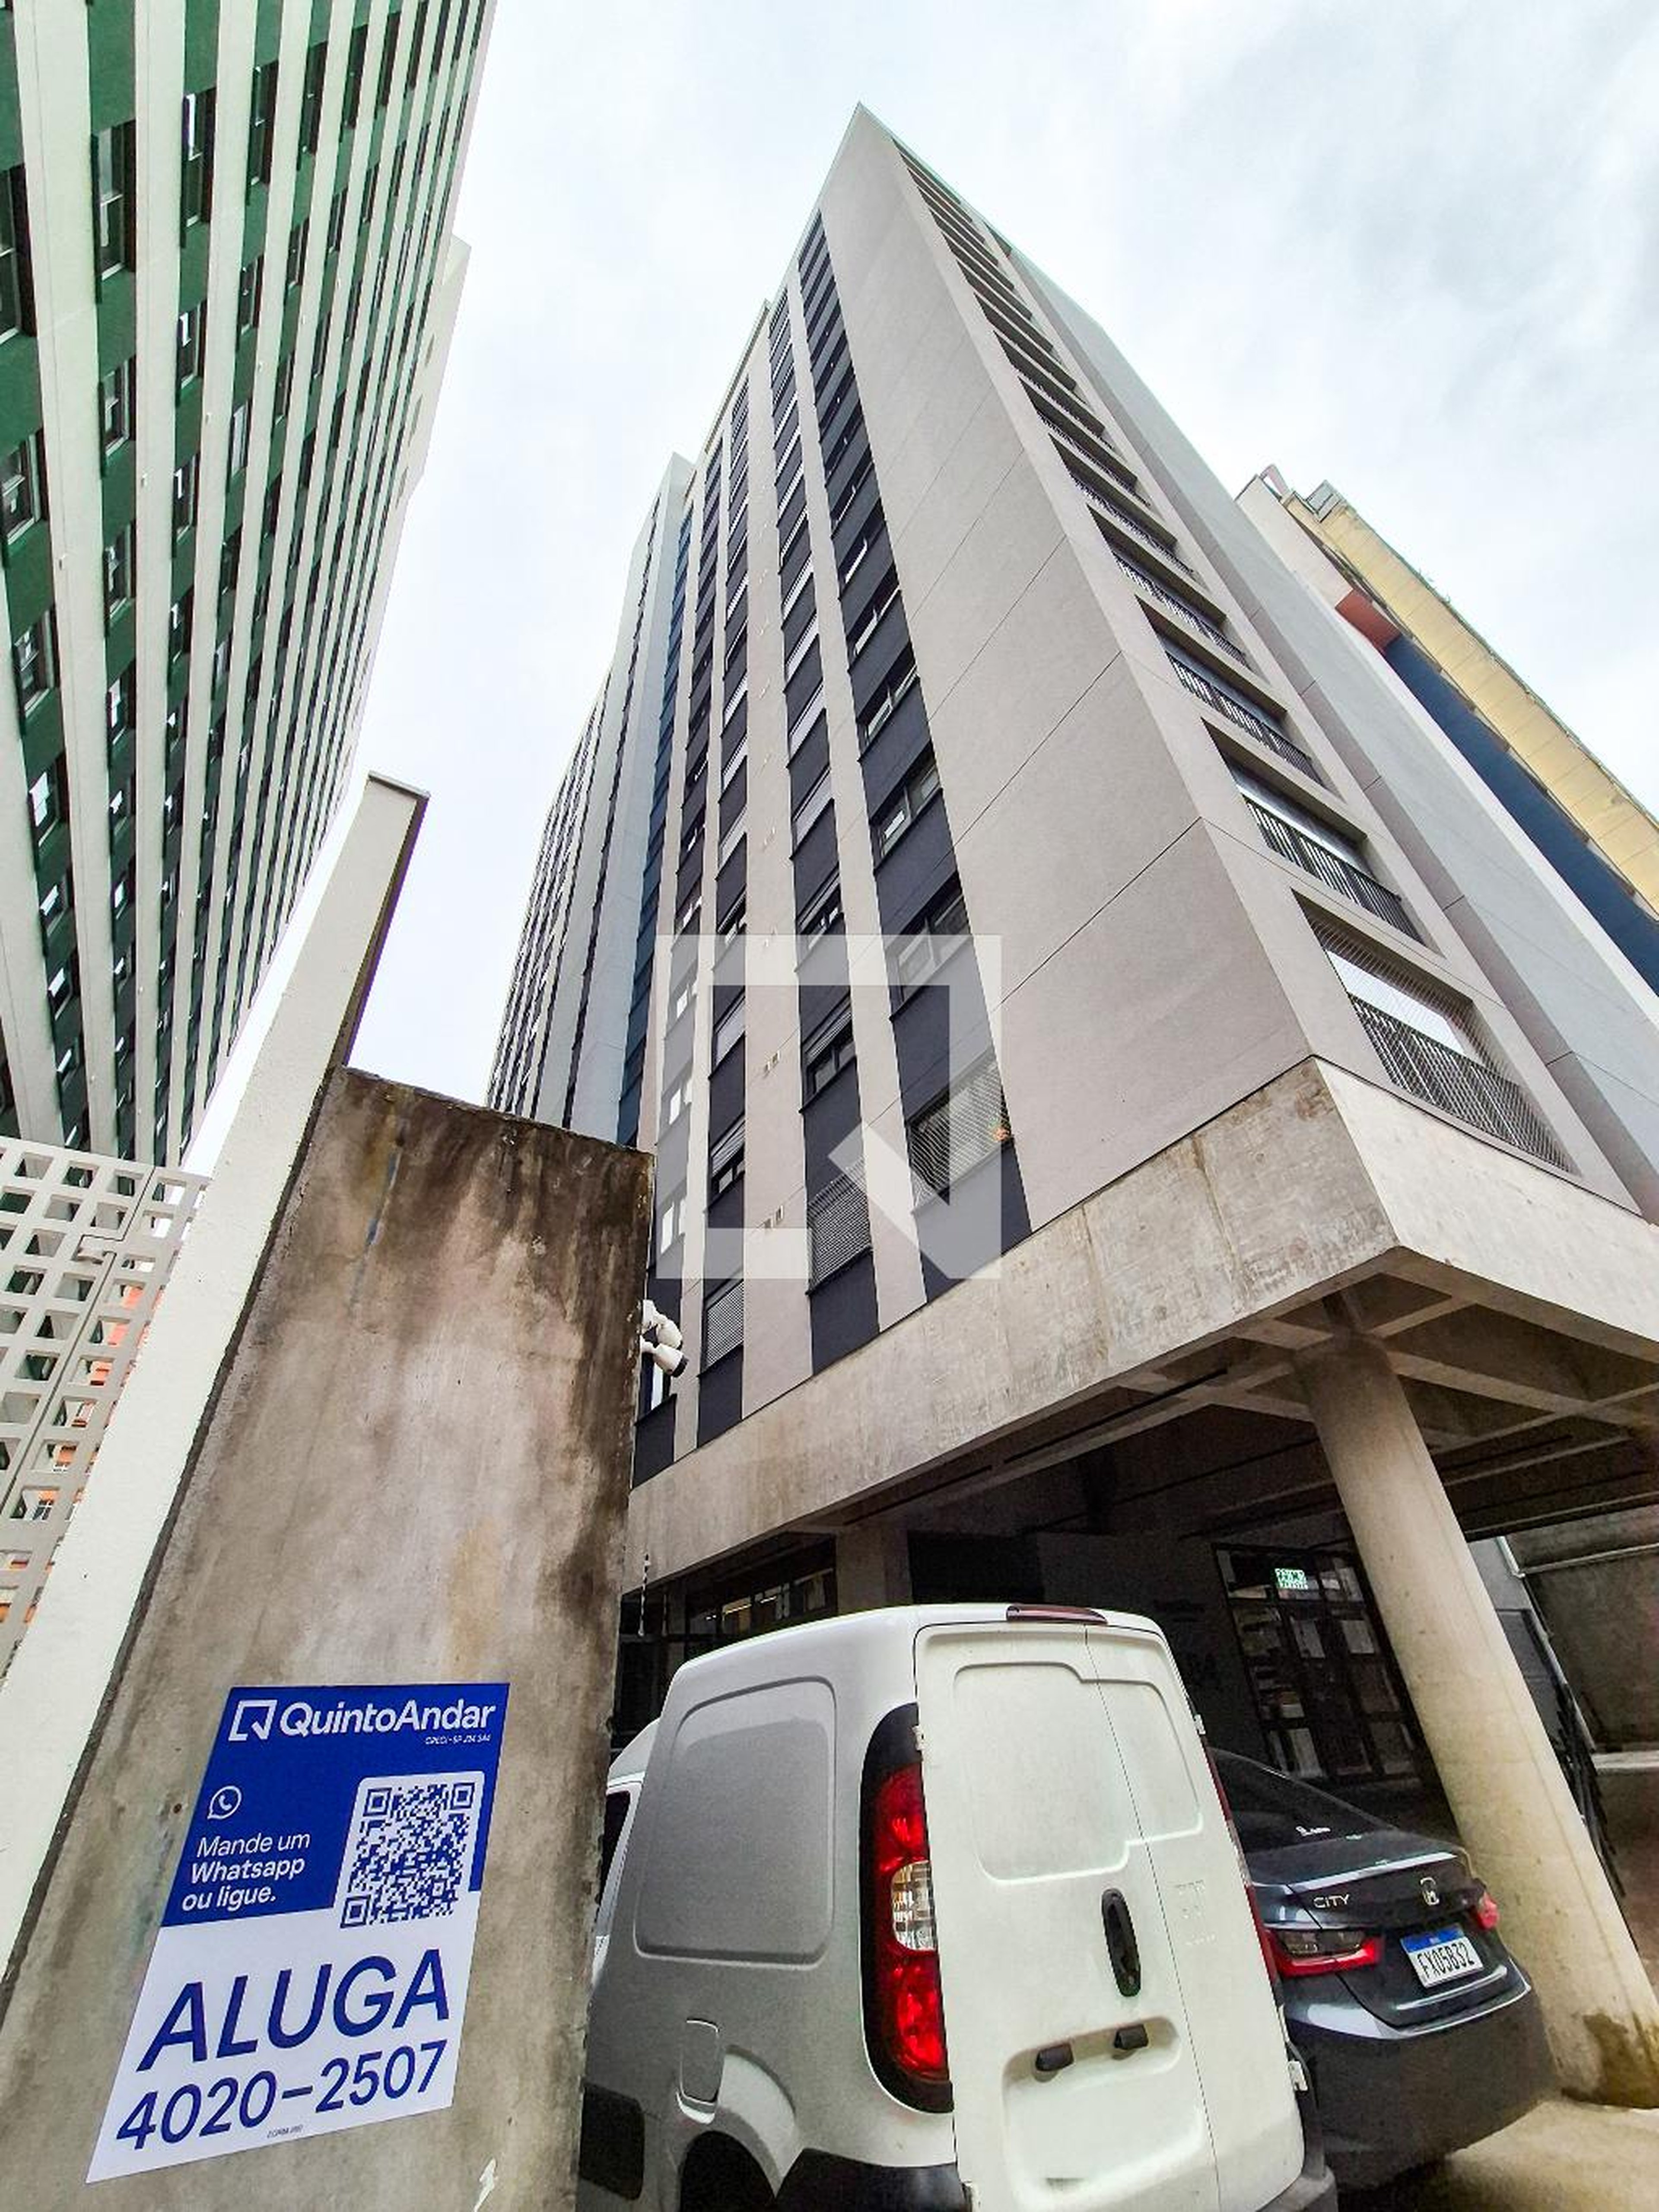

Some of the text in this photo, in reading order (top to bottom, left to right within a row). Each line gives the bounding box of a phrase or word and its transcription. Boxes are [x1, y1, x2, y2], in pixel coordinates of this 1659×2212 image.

[280, 1699, 496, 1737] QuintoAndar
[197, 1832, 311, 1858] Mande um
[191, 1858, 305, 1884] Whatsapp
[182, 1884, 276, 1912] ou ligue.
[1313, 1894, 1350, 1908] CITY
[136, 1949, 449, 2072] ALUGA
[116, 2040, 448, 2150] 4020-2507
